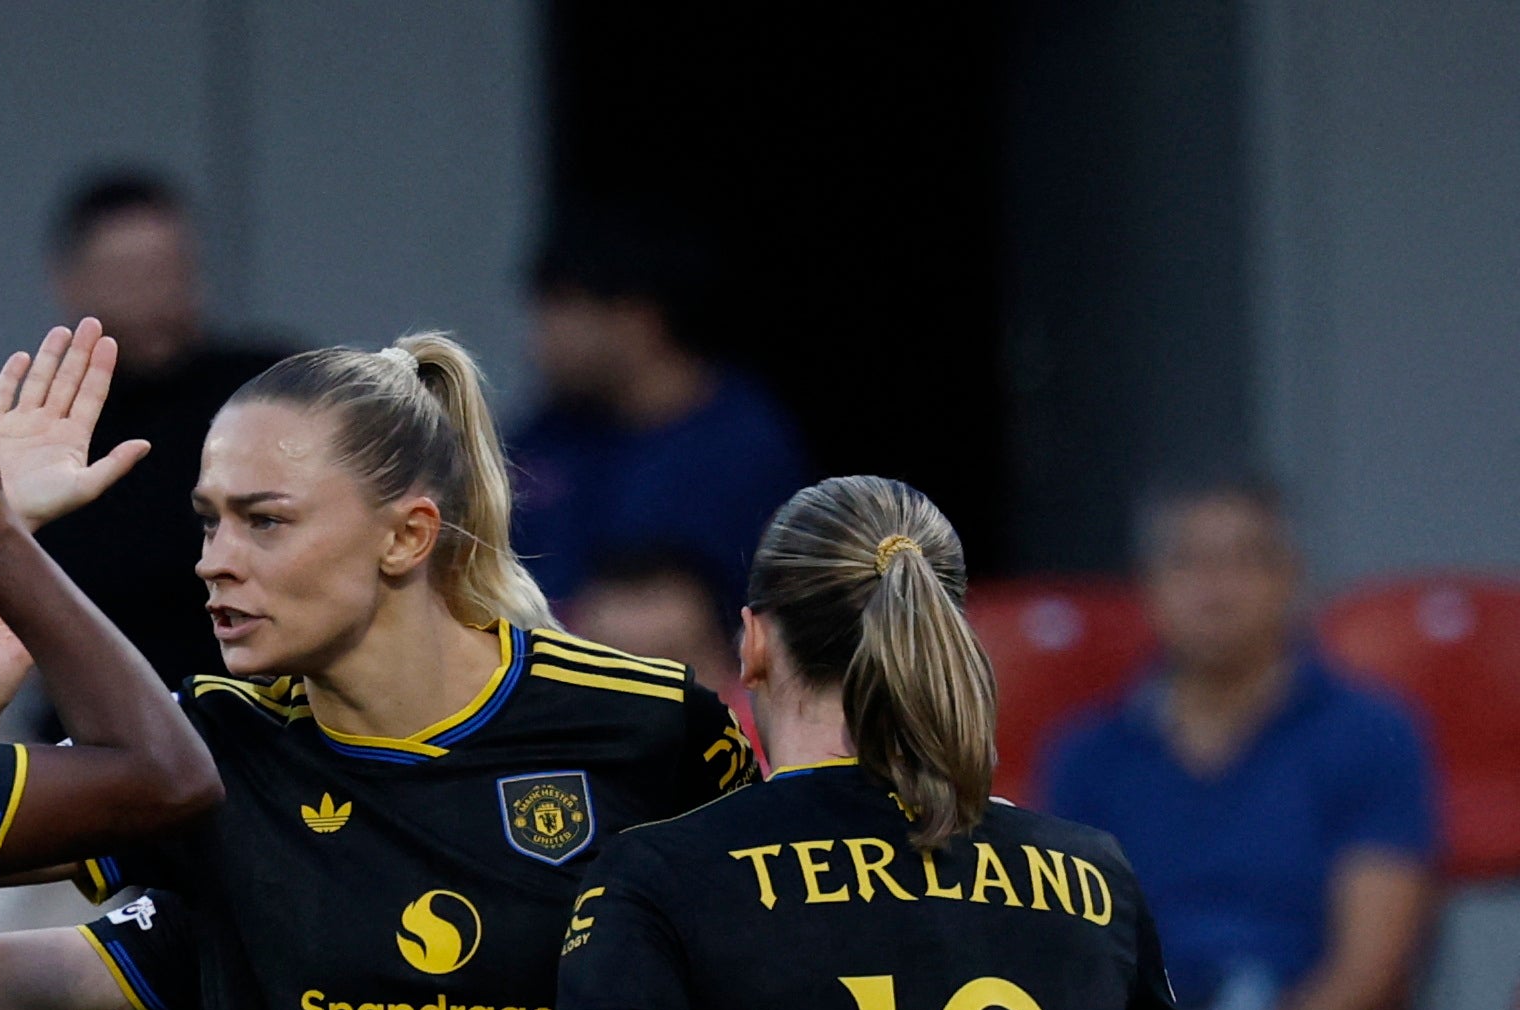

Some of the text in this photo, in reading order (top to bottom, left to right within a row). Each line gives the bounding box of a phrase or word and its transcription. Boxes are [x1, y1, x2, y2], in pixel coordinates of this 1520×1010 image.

[518, 788, 575, 812] MANCHESTER
[532, 831, 573, 844] UNITED
[728, 837, 1113, 926] TERLAND
